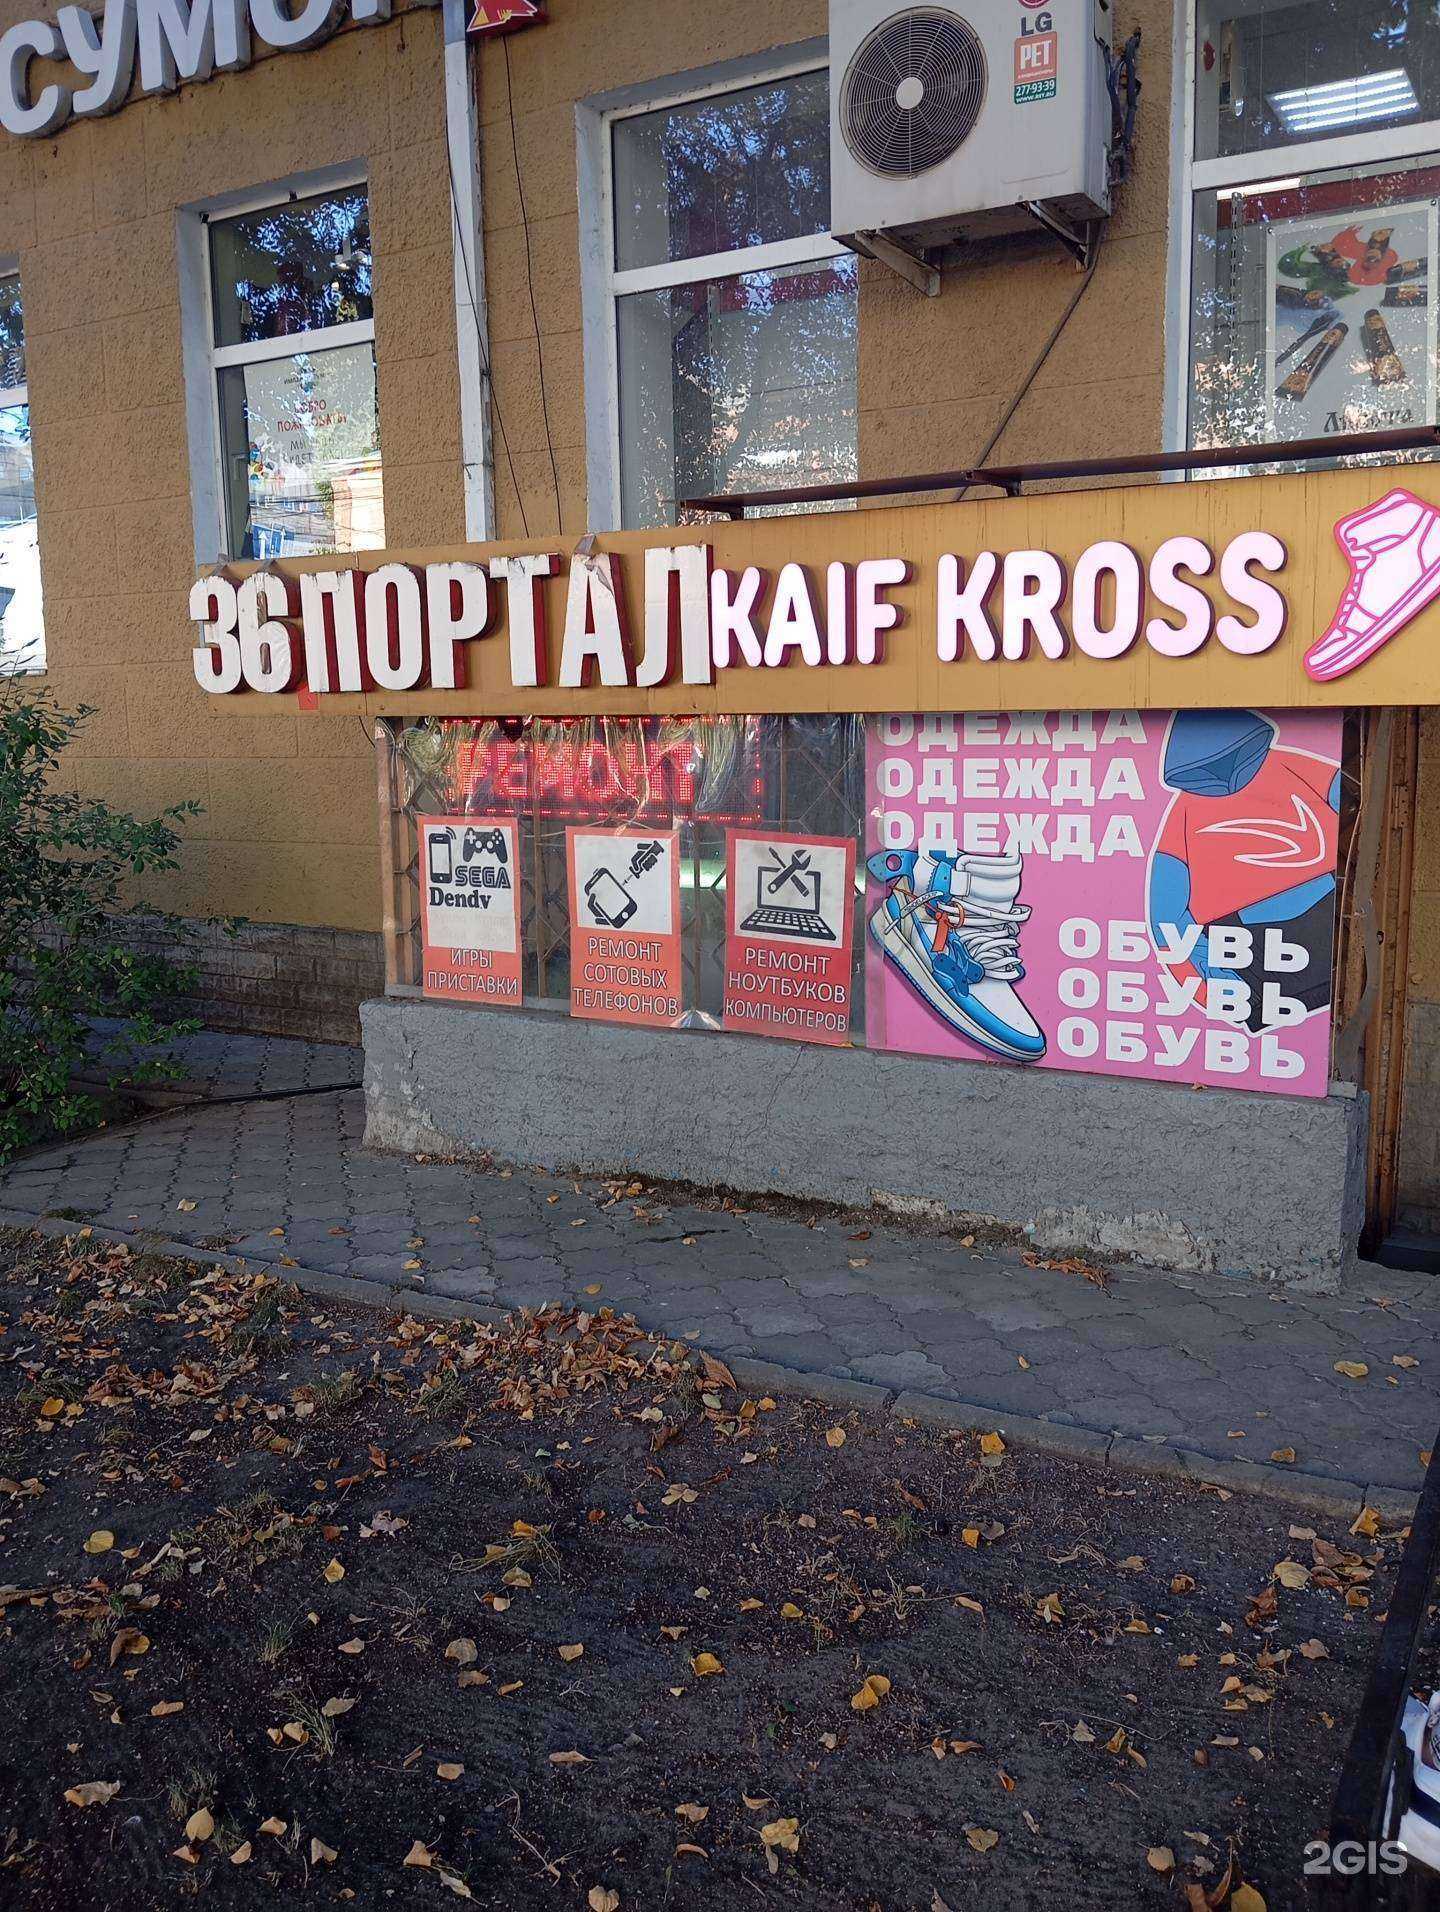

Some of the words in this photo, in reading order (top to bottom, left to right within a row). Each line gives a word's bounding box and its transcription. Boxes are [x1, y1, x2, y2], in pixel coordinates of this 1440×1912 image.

[1021, 12, 1052, 36] LG
[1016, 79, 1055, 97] 277-93-39
[710, 558, 907, 668] KAIF
[937, 531, 1286, 662] KROSS
[877, 711, 1148, 753] ОДЕЖДА
[876, 757, 1146, 806] ОДЕЖДА
[876, 810, 1146, 863] ОДЕЖДА
[455, 866, 511, 889] SEGA
[450, 949, 492, 968] ИГРЫ
[588, 936, 662, 962] РЕМОНТ
[744, 947, 831, 975] РЕМОНТ
[1058, 917, 1310, 973] ОБУВЬ
[427, 971, 518, 996] ПРИСТАВКИ
[584, 962, 667, 989] СОТОВЫХ
[728, 970, 846, 1004] НОУТБУКОВ
[573, 987, 678, 1017] ТЕЛЕФОНОВ
[1057, 967, 1308, 1026] ОБУВЬ
[725, 998, 847, 1032] КОМПЬЮТЕРОВ
[1057, 1016, 1306, 1079] ОБУВЬ
